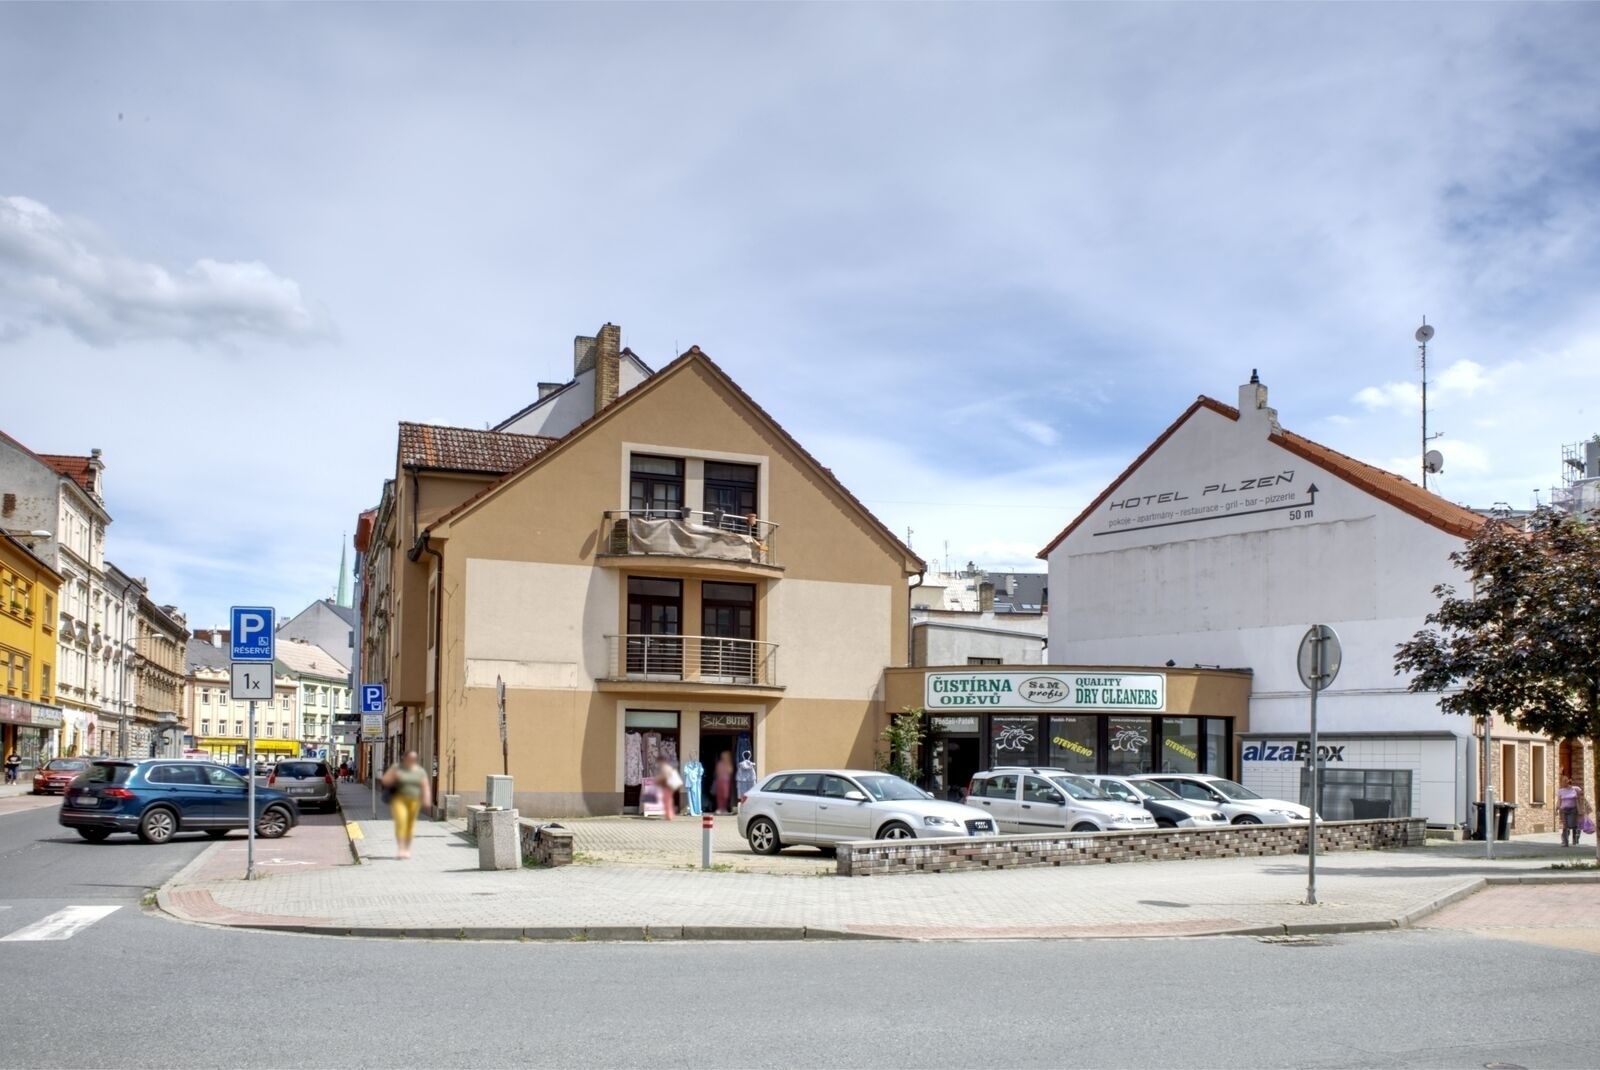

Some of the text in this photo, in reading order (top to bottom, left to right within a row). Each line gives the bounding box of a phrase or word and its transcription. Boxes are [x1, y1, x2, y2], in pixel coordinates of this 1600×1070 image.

[1110, 491, 1188, 510] HOTEL
[1109, 516, 1131, 528] pokoje
[1180, 504, 1219, 516] restaurace
[1225, 500, 1238, 511] gril
[1245, 497, 1258, 507] bar
[1265, 492, 1295, 505] pizzerie
[1289, 510, 1313, 520] 50 m
[240, 613, 265, 644] P
[933, 676, 1012, 693] ČISTÍRNA
[1075, 677, 1122, 687] QUALITY
[366, 688, 380, 704] P
[940, 693, 1002, 705] ODĚVŮ
[1075, 688, 1158, 705] DRY CLEANERS
